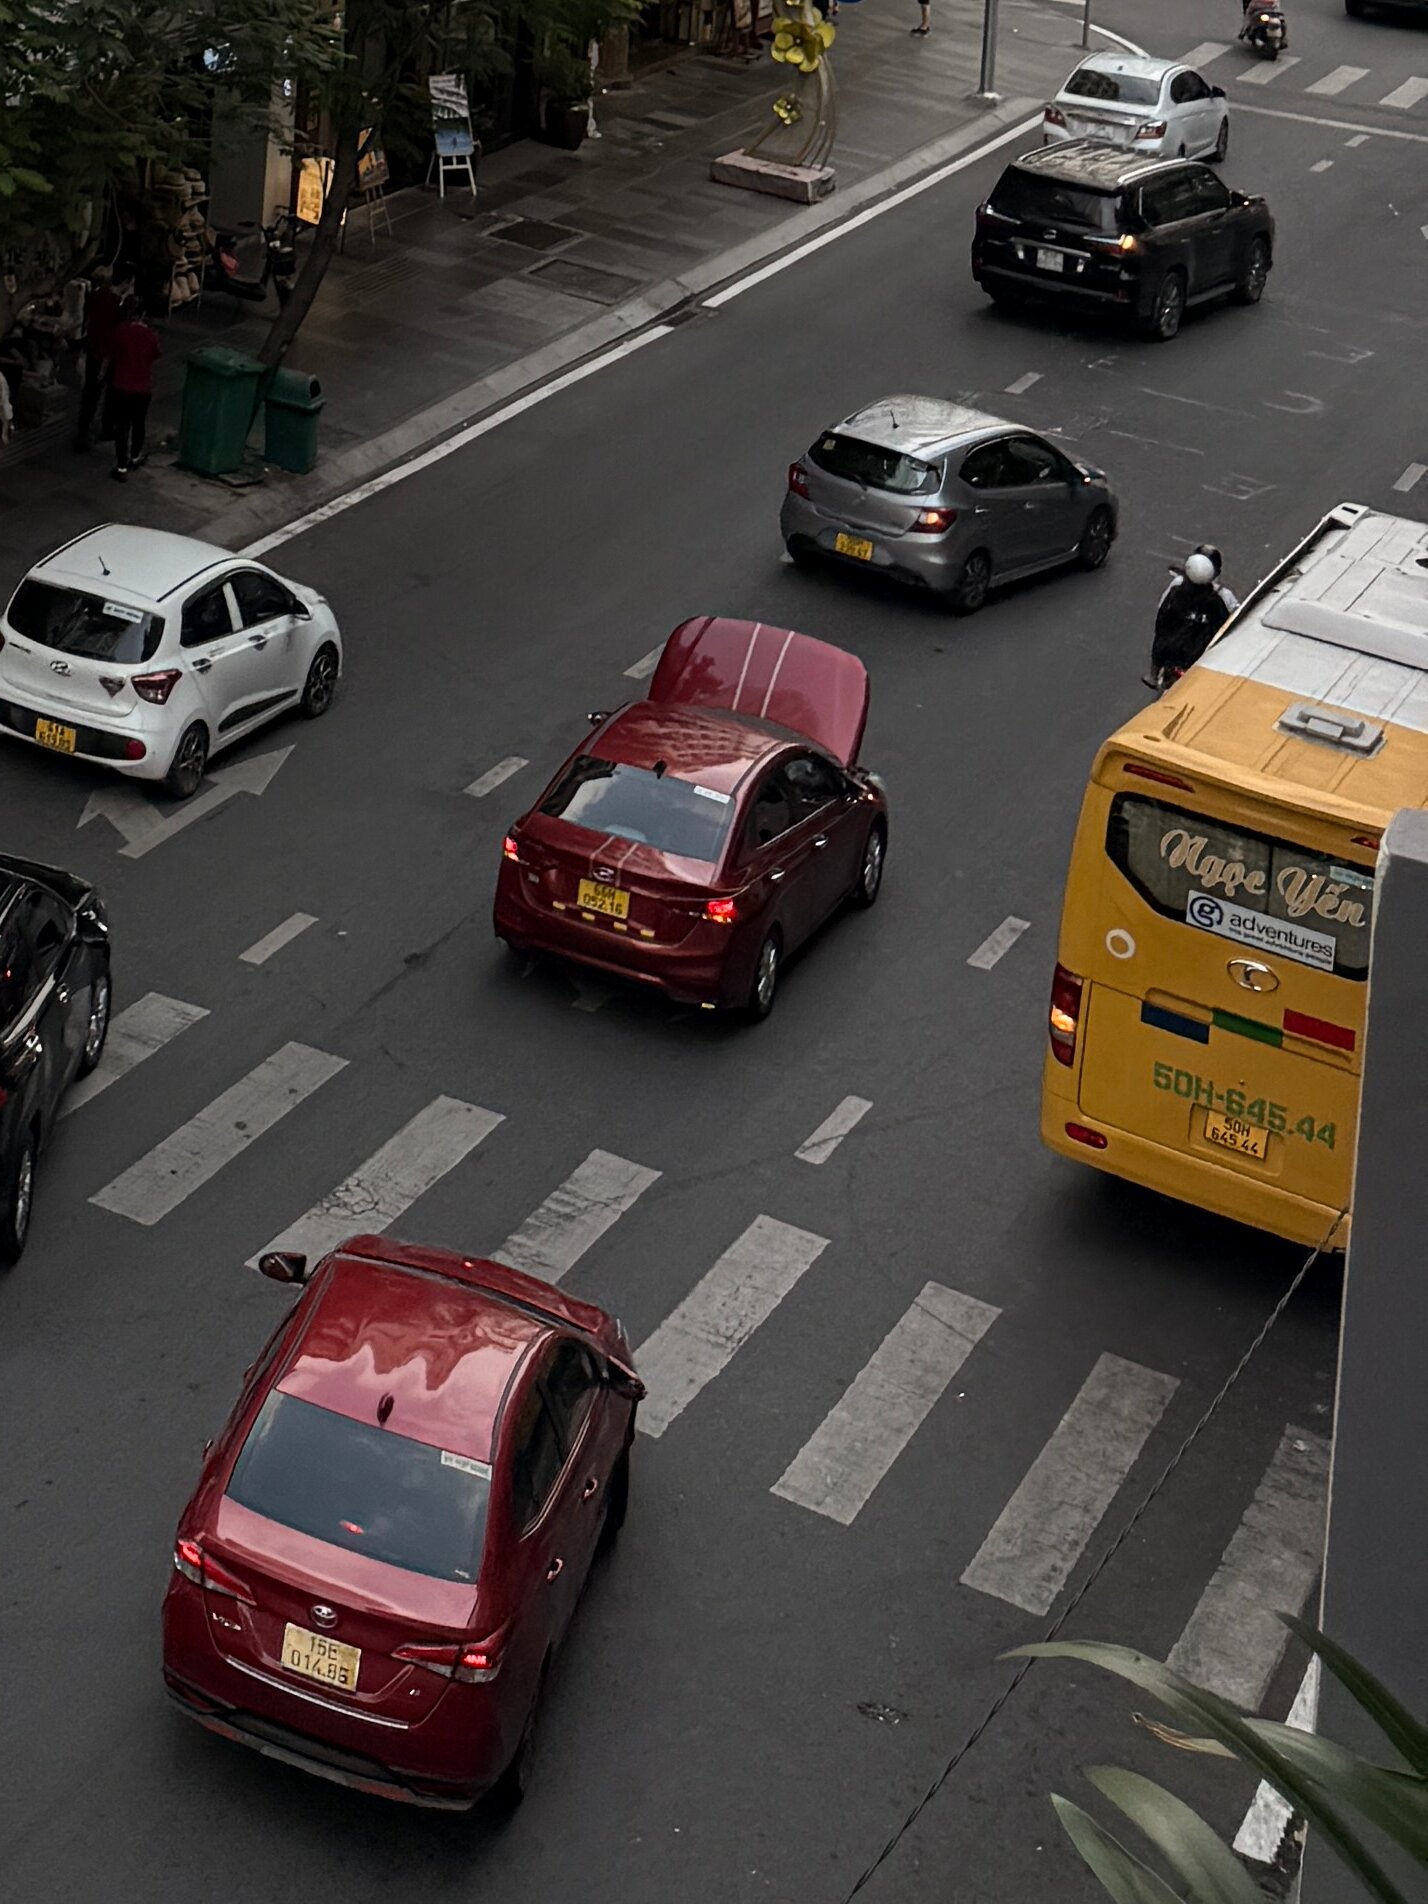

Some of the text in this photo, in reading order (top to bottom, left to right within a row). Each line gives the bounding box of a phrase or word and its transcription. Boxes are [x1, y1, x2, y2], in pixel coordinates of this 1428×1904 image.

[1160, 829, 1366, 927] Ngọc Yến
[1229, 911, 1334, 959] adventures
